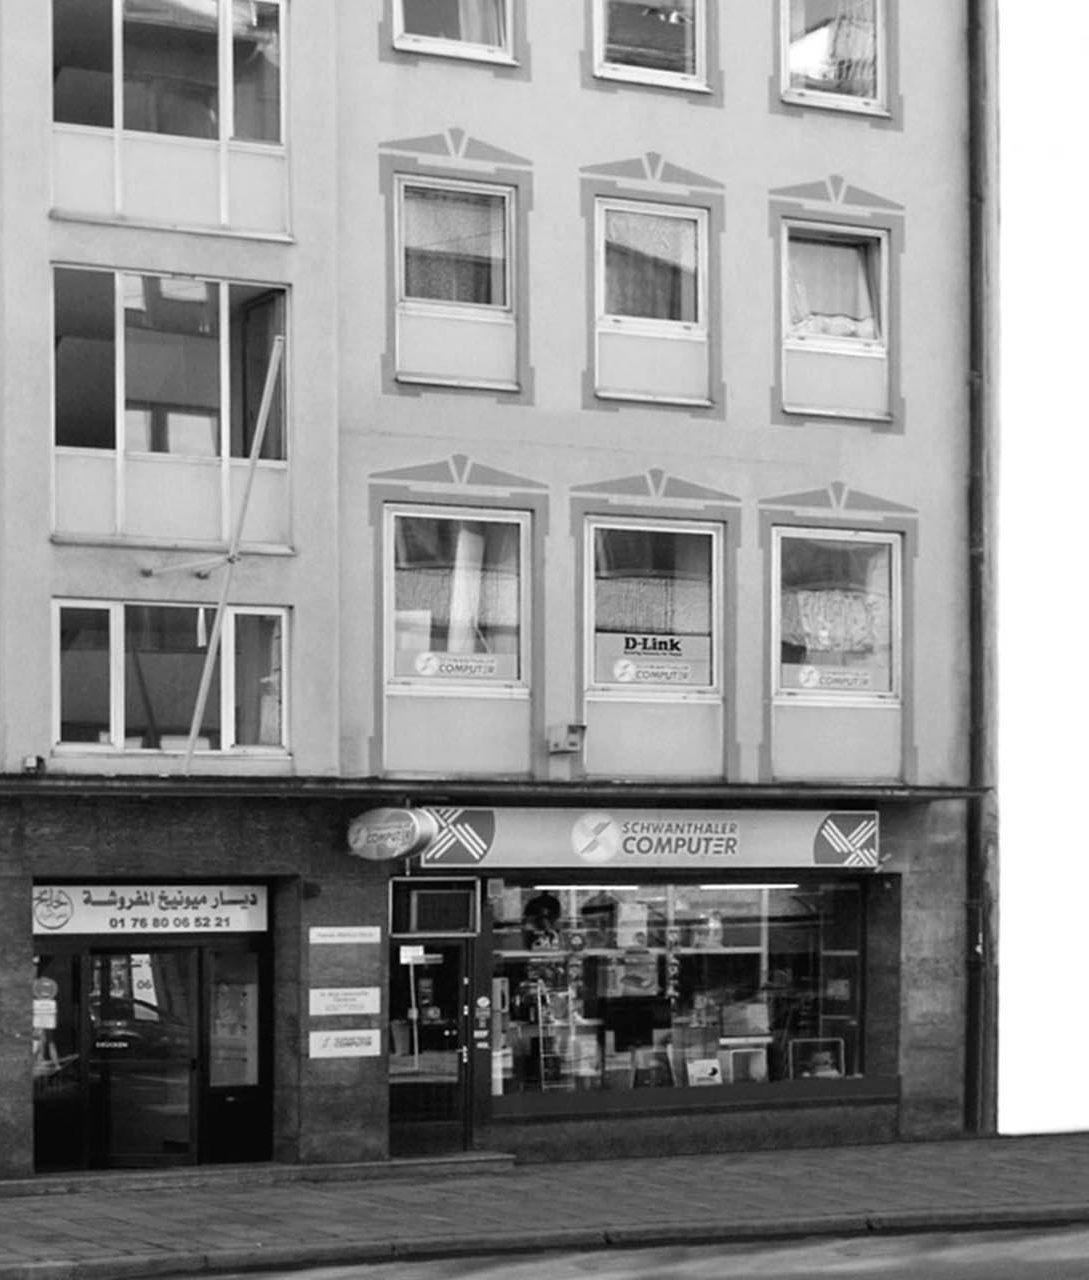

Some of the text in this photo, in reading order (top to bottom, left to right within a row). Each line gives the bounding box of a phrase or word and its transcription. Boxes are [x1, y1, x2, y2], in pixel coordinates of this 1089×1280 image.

[624, 636, 682, 652] D-Link
[622, 822, 739, 835] SCHWANTHALER
[622, 836, 739, 855] COMPUTER
[108, 917, 126, 929] 01
[131, 917, 148, 929] 76
[152, 917, 169, 928] 80
[194, 916, 211, 928] 52
[215, 916, 232, 928] 21
